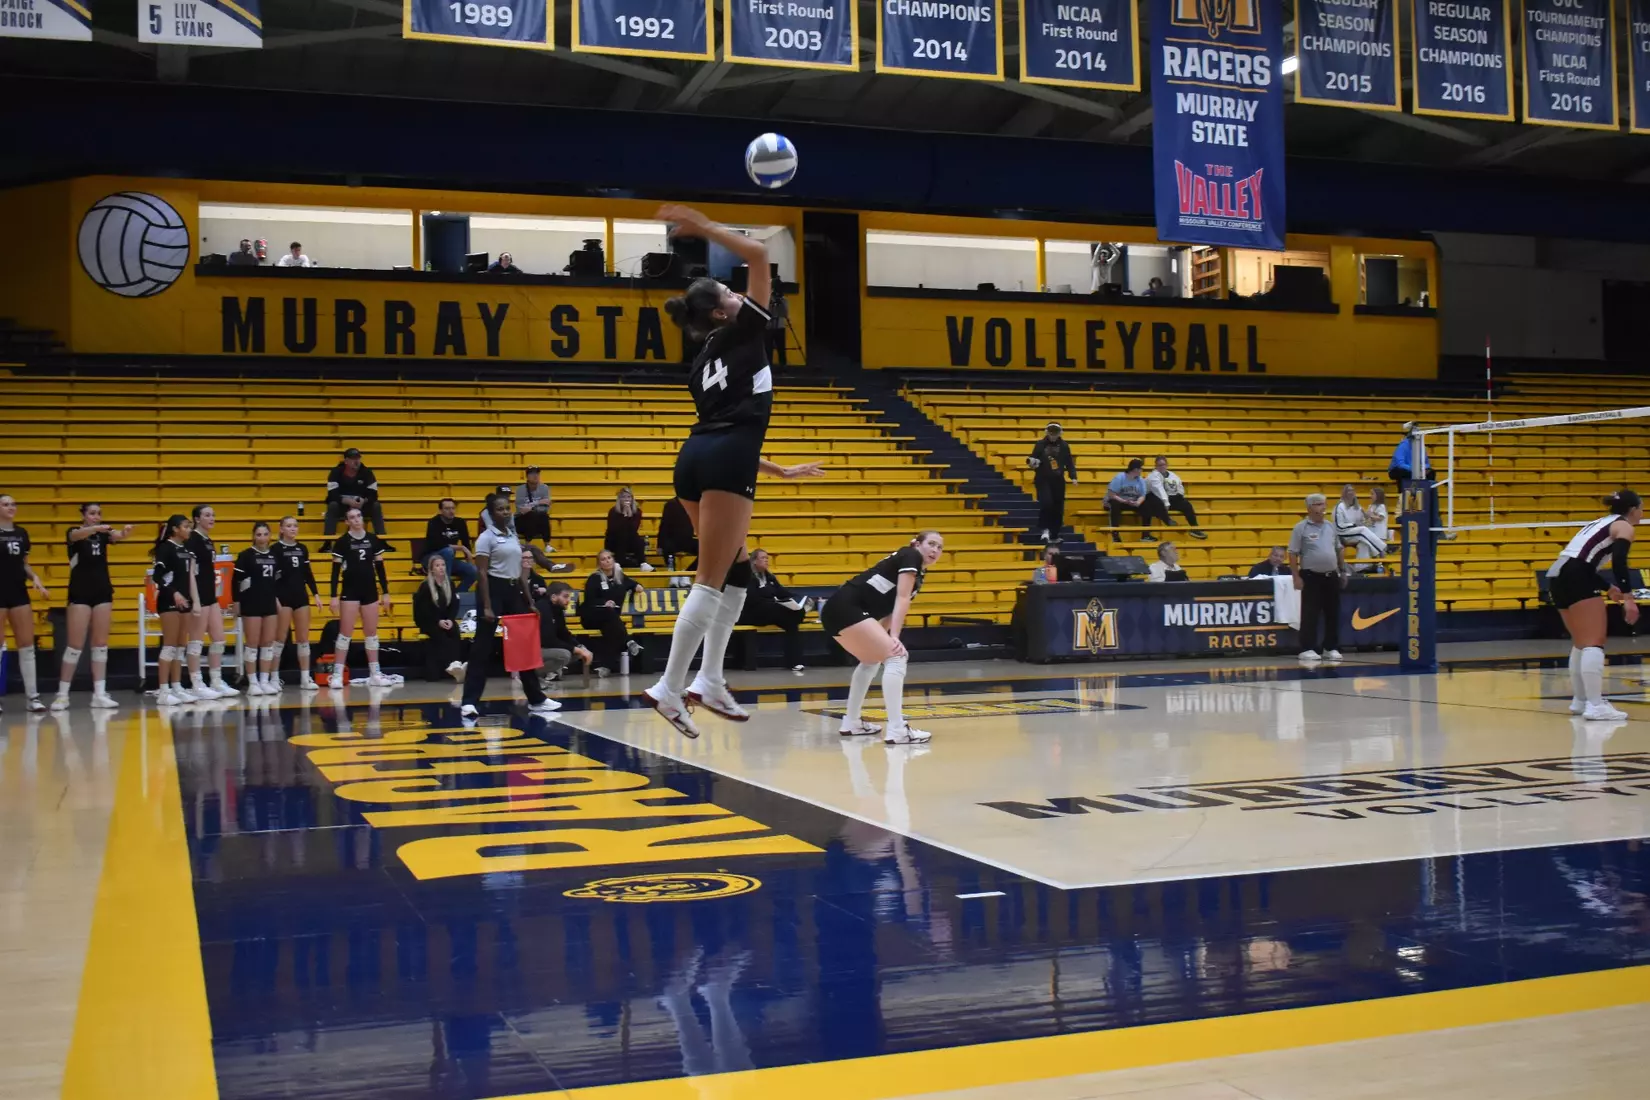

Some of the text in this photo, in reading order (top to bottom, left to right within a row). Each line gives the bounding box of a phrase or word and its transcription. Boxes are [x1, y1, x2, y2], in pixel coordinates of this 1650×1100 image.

[1, 11, 43, 29] BROCK
[148, 4, 163, 35] 5
[175, 3, 197, 19] LILY
[450, 3, 513, 27] 1989
[749, 0, 834, 20] First Round
[886, 0, 991, 22] CHAMPIONS
[1057, 4, 1102, 24] NCAA
[1428, 4, 1491, 22] REGULAR
[1527, 10, 1606, 30] TOURNAMENT
[175, 20, 213, 38] EVANS
[615, 15, 675, 39] 1992
[1042, 23, 1118, 43] First Round
[1318, 12, 1375, 33] SEASON
[765, 27, 823, 51] 2003
[1433, 25, 1488, 45] SEASON
[1535, 28, 1602, 47] CHAMPIONS
[912, 38, 968, 62] 2014
[1302, 35, 1391, 58] CHAMPIONS
[1055, 49, 1107, 72] 2014
[1163, 45, 1271, 86] RACERS
[1419, 47, 1503, 69] CHAMPIONS
[1552, 53, 1588, 70] NCAA
[1325, 71, 1372, 93] 2015
[1539, 69, 1600, 87] First Round
[1441, 82, 1486, 104] 2016
[1551, 92, 1592, 113] 2016
[1176, 92, 1259, 122] MURRAY
[1192, 121, 1249, 147] STATE
[1205, 163, 1234, 178] THE
[1174, 159, 1264, 220] VALLEY
[222, 297, 509, 358] MURRAY
[945, 315, 1267, 373] VOLLEYBALL
[701, 357, 729, 392] 4
[7, 541, 20, 555] 15
[359, 549, 366, 560] 2
[262, 564, 273, 577] 21
[291, 556, 300, 568] 9
[1407, 520, 1420, 660] RACERS
[1163, 601, 1276, 627] MURRAY S
[1208, 633, 1278, 648] RACERS
[287, 727, 827, 880] RACERS
[979, 766, 1554, 820] MURRAY
[1294, 784, 1650, 822] VOLLEY
